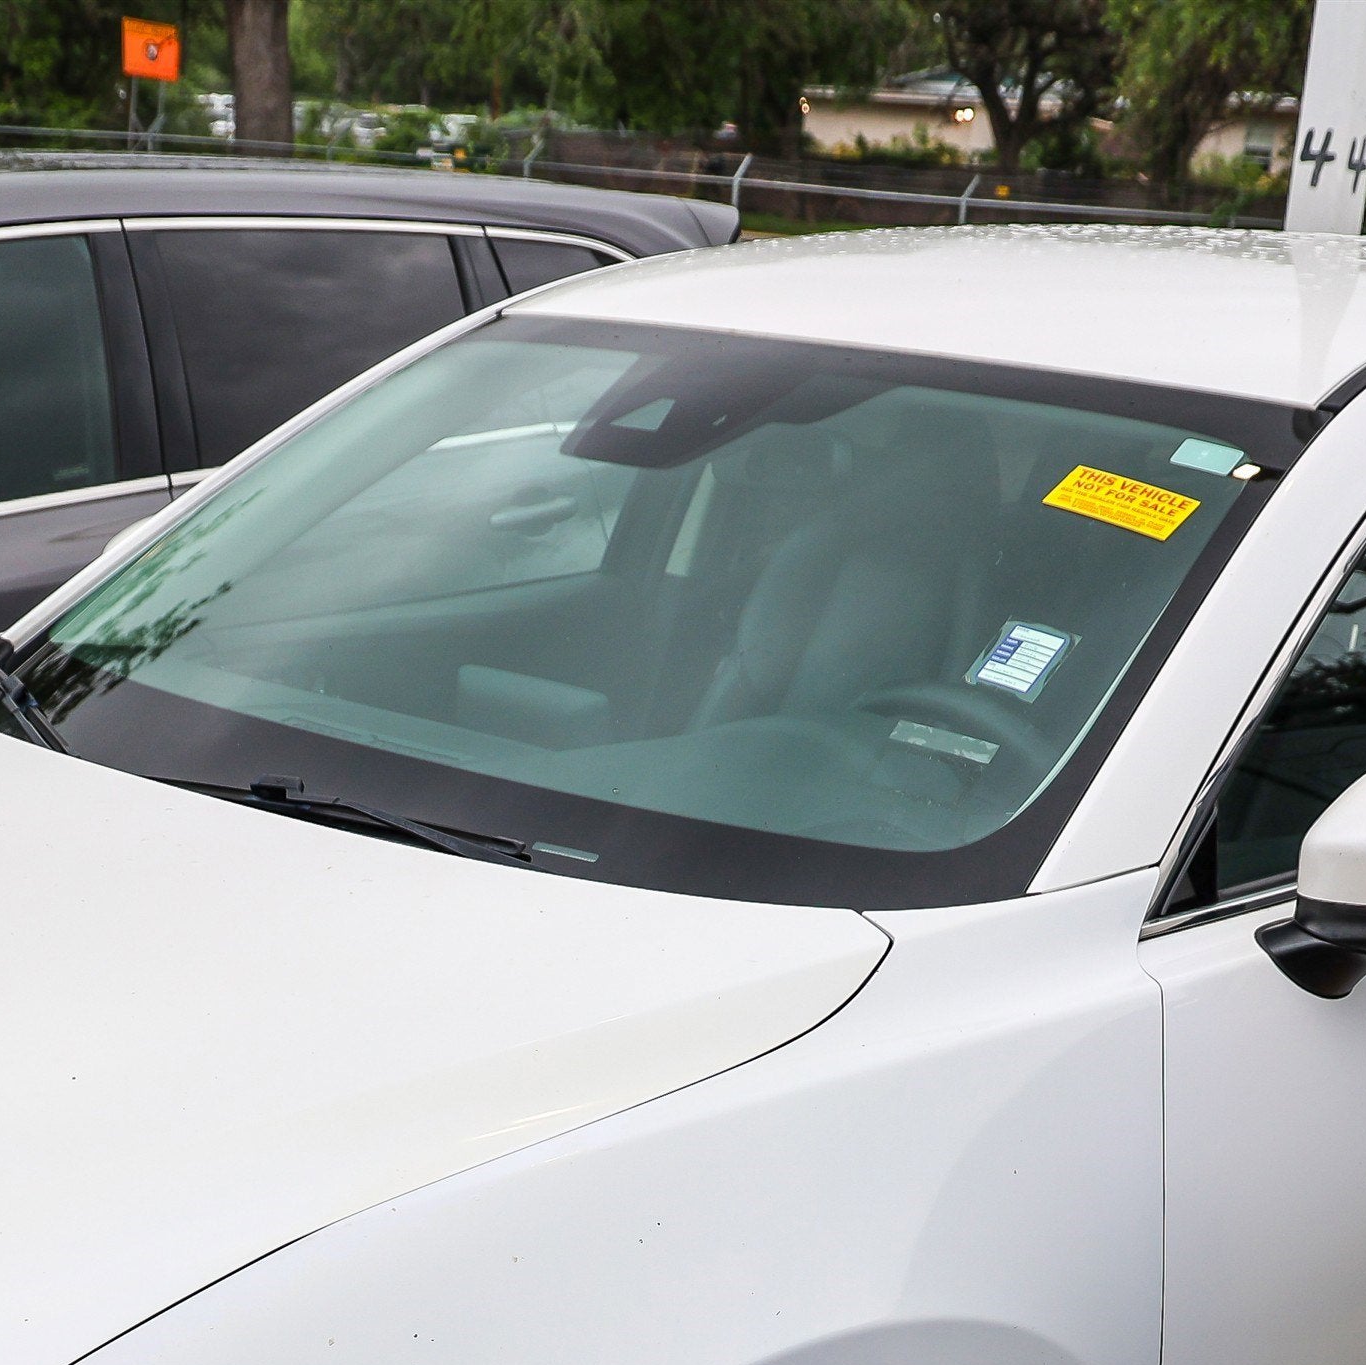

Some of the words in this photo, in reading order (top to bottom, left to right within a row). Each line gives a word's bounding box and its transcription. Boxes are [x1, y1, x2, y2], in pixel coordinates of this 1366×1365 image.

[1073, 480, 1102, 493] NOT
[1104, 488, 1137, 503] FOR
[1139, 499, 1176, 517] SALE
[1078, 468, 1117, 486] THIS
[1120, 480, 1193, 511] VEHICLE
